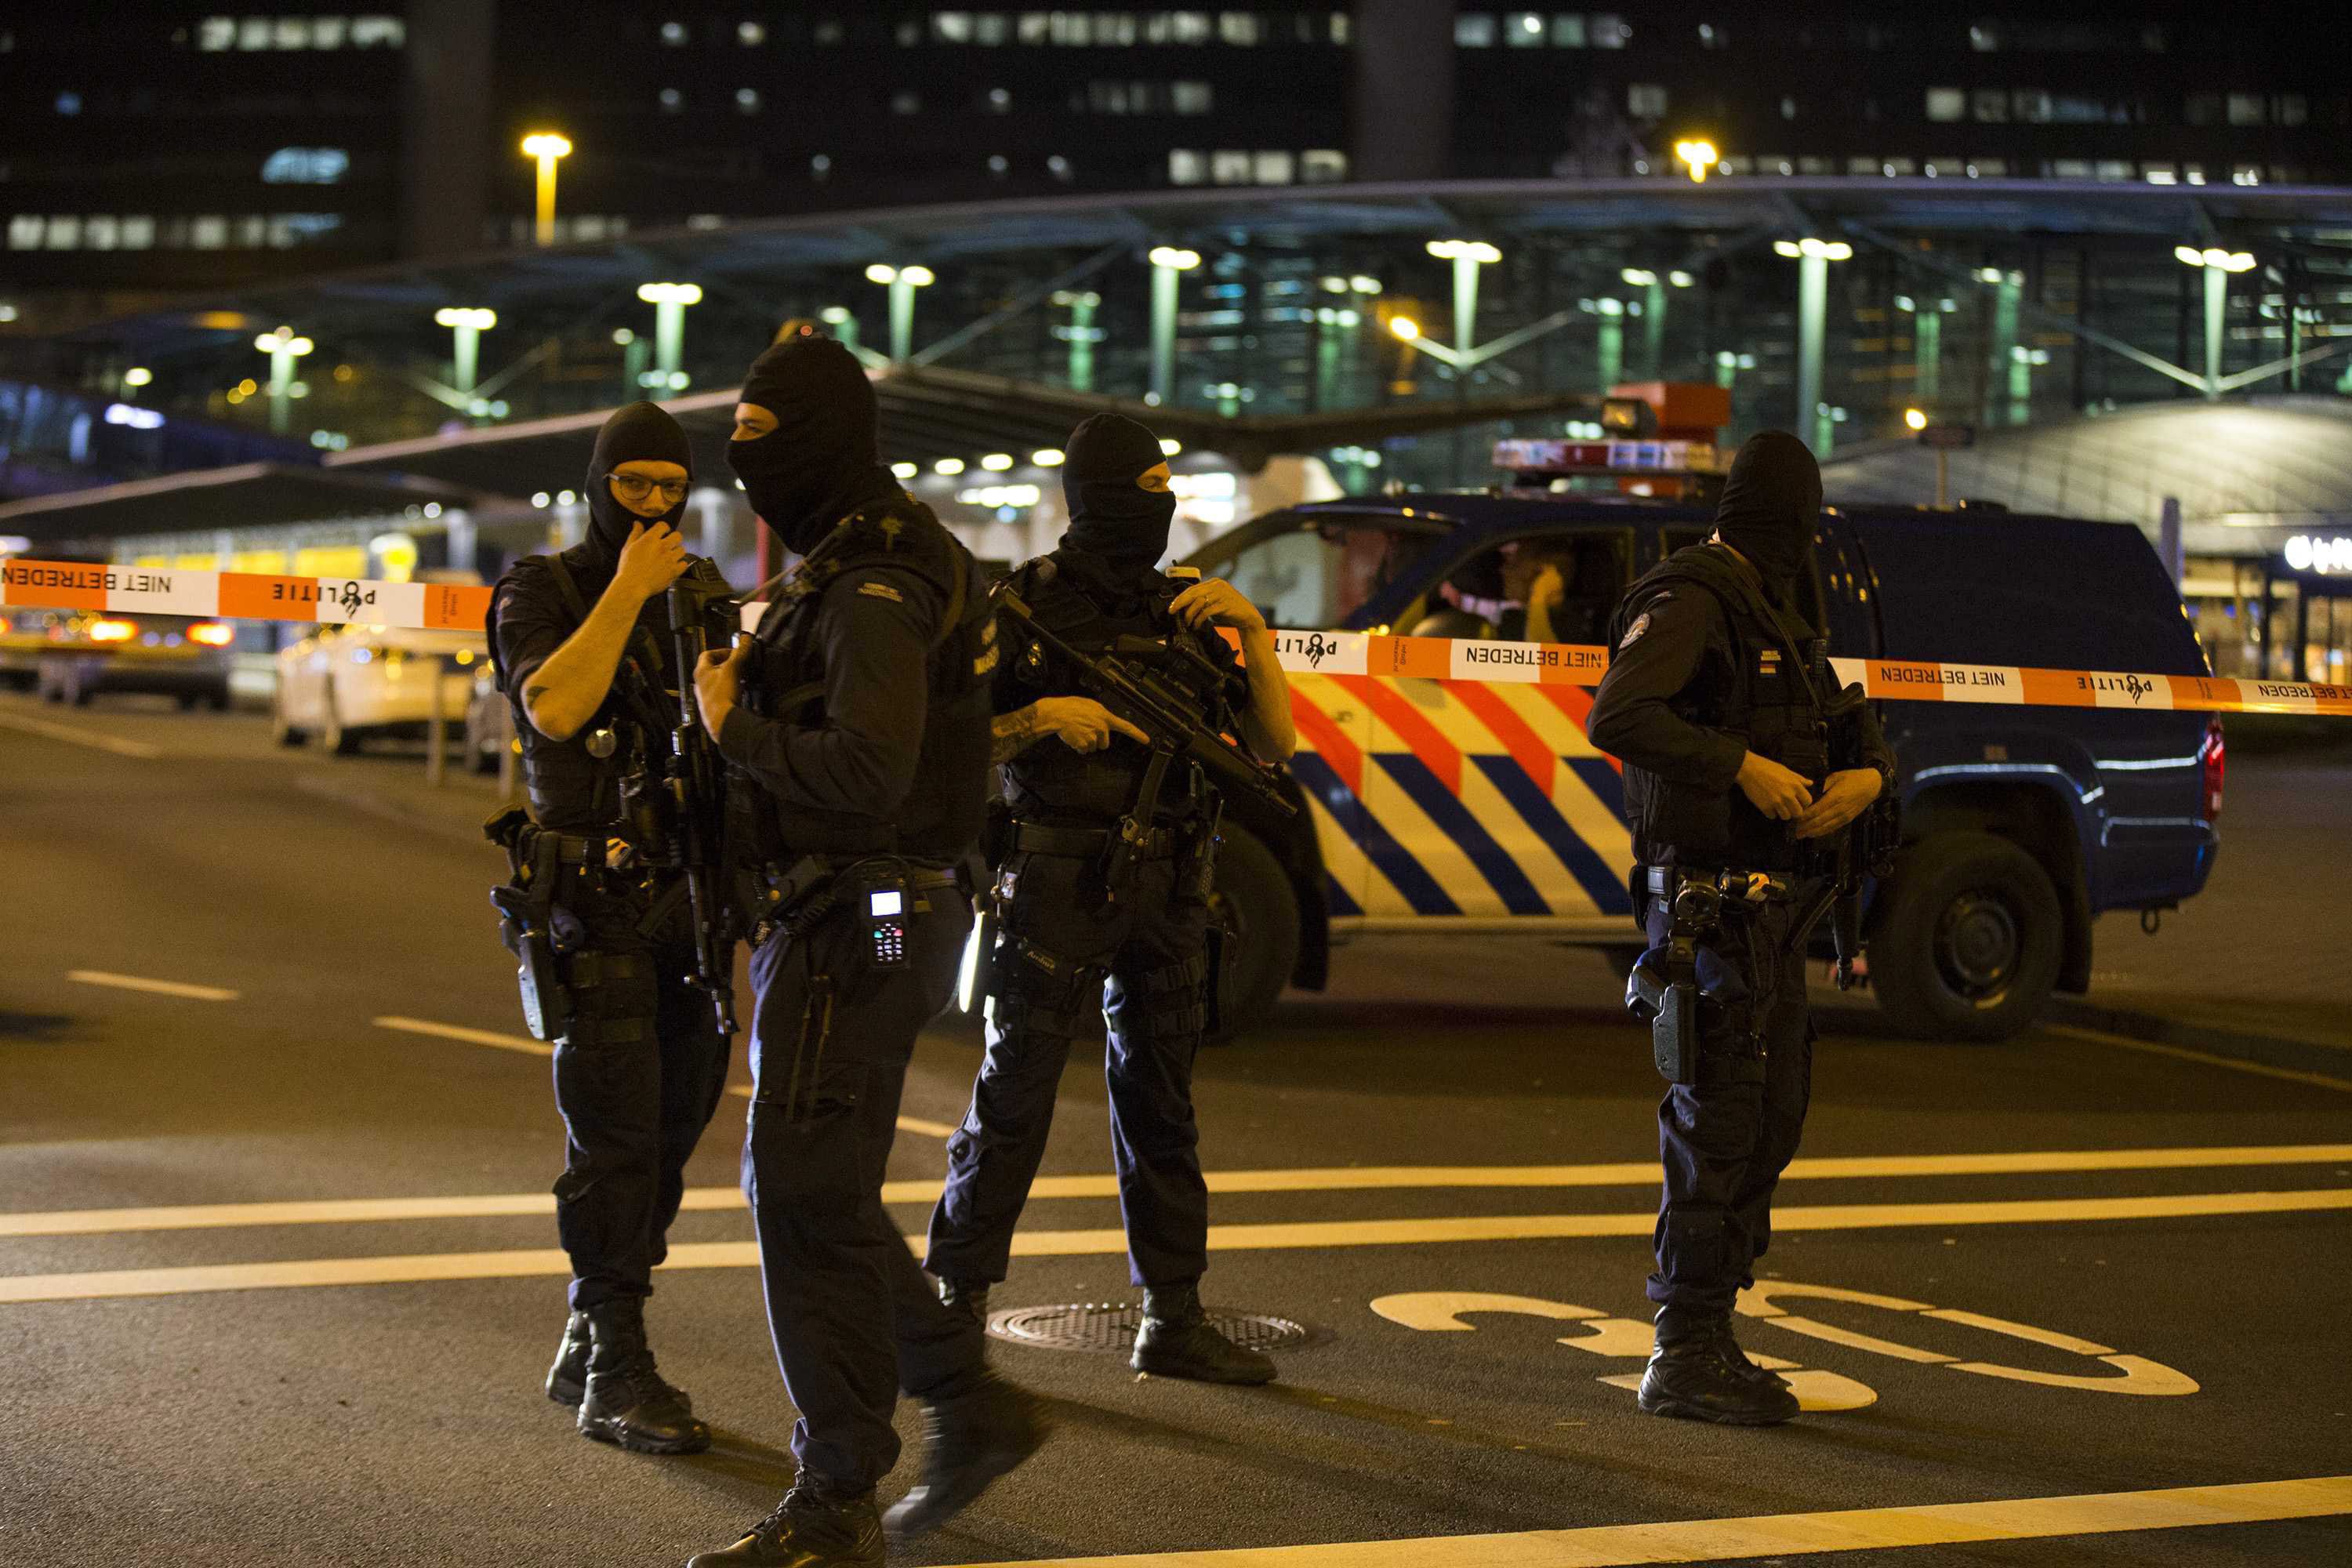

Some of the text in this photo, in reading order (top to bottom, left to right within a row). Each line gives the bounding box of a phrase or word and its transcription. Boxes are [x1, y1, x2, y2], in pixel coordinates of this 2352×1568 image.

[2, 567, 172, 593] NIET BETREDEN
[1273, 633, 1338, 662] POLIT
[1466, 647, 1602, 668] NIET BETREDEN
[1881, 666, 2005, 686] NIET BETREDEN
[2257, 684, 2338, 699] BETREDEN
[1368, 1278, 2201, 1412] 30
